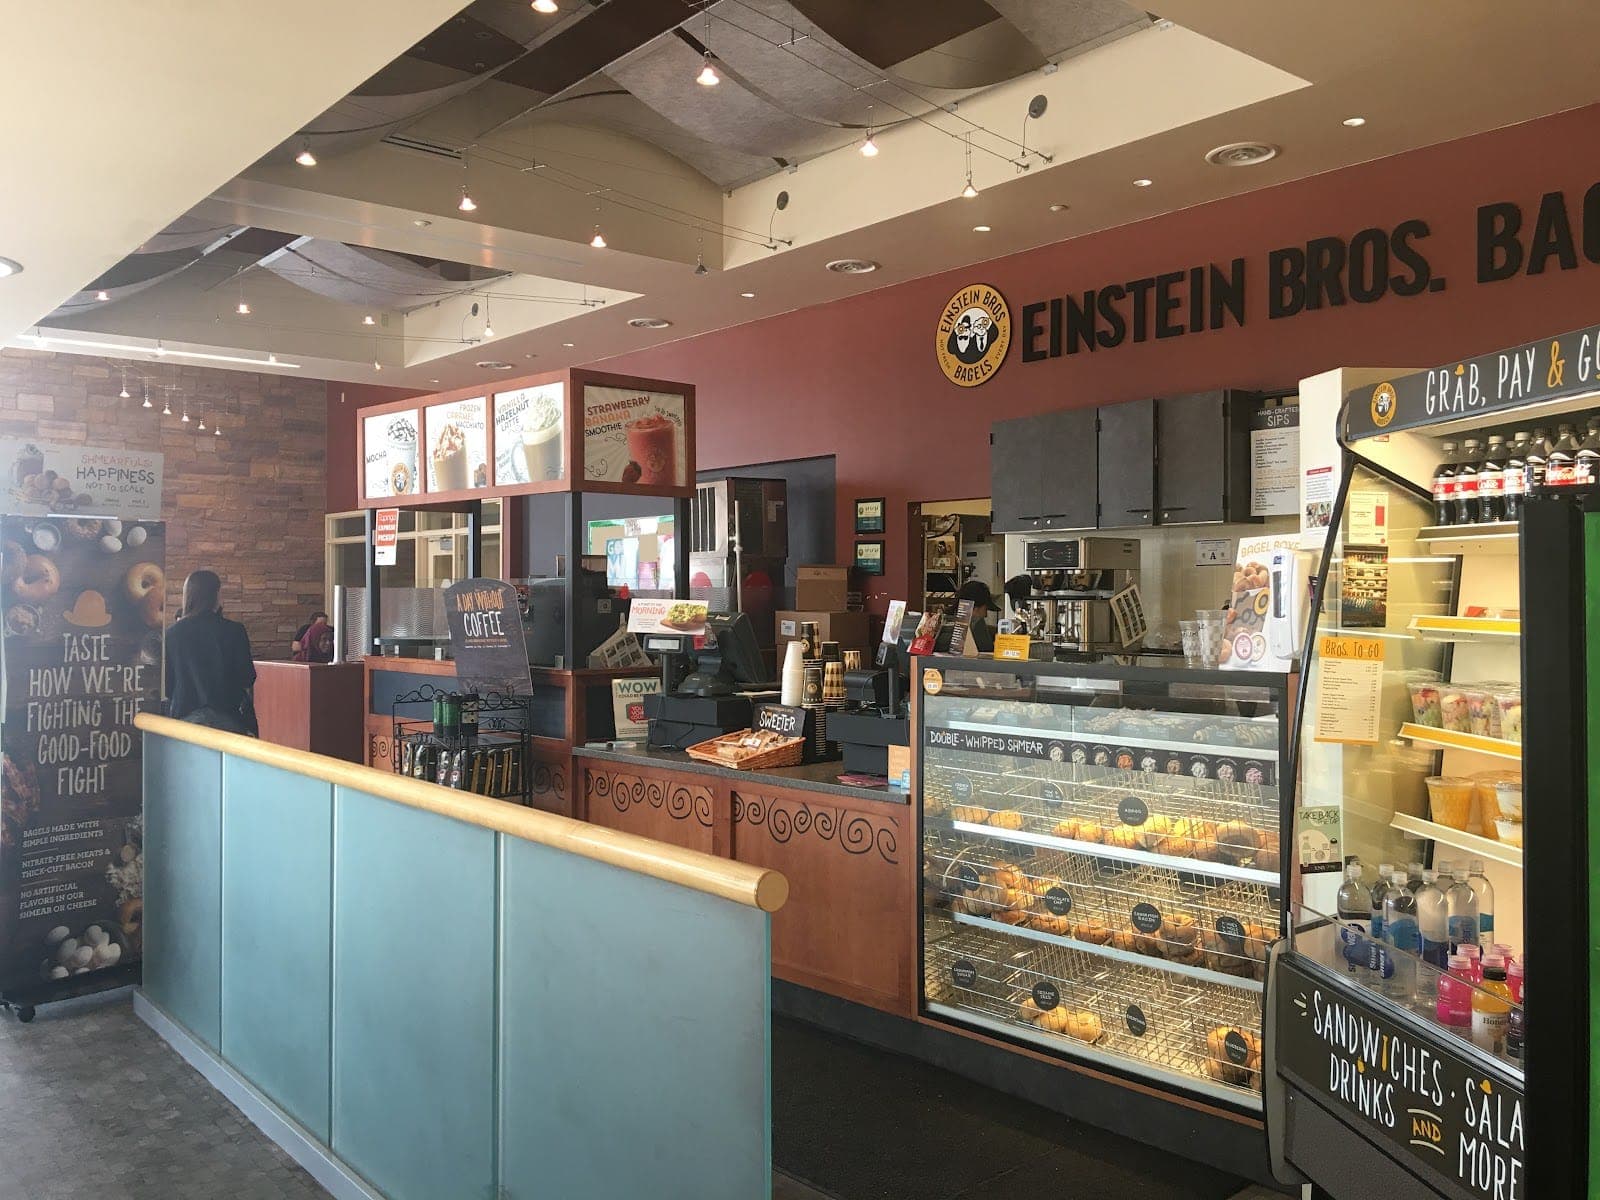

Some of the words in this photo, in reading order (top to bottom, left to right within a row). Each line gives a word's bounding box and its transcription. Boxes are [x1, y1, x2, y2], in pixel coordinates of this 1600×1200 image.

[1022, 258, 1245, 362] EINSTEIN
[1269, 219, 1445, 319] BROS.
[941, 290, 980, 333] EINSTEIN
[983, 291, 1006, 322] BROS
[954, 360, 993, 382] BAGELS
[1425, 362, 1487, 416] GRAB,
[1497, 346, 1537, 400] PAY
[1546, 340, 1567, 388] &
[1577, 331, 1600, 383] G
[495, 399, 530, 426] HAZELNUT
[587, 396, 651, 416] STRAWBERRY
[585, 410, 631, 427] BANANA
[1267, 413, 1290, 427] SIPS
[585, 422, 622, 437] SMOOTHIE
[366, 450, 387, 464] MOCHA
[76, 466, 155, 484] HAPPINESS
[106, 482, 117, 492] TO
[1241, 541, 1271, 558] BAGEL
[463, 611, 505, 637] COFFEE
[63, 633, 110, 662] TASTE
[1325, 640, 1348, 657] BROS.
[1353, 642, 1363, 658] TO
[1368, 643, 1379, 658] GO
[30, 667, 73, 698] HOW
[82, 665, 144, 694] WE'RE
[618, 681, 657, 693] WOW
[27, 699, 102, 732] FIGHTING
[759, 711, 796, 731] SWEETER
[38, 730, 131, 765] GOOD-FOOD
[1007, 738, 1044, 755] SHMEAR
[58, 764, 108, 795] FIGHT
[22, 837, 49, 849] SIMPLE
[49, 829, 104, 843] INGREDIENTS
[23, 824, 51, 838] BAGELS
[51, 822, 75, 833] MADE
[76, 820, 100, 831] WITH
[22, 852, 76, 869] NITRATE-FREE
[77, 849, 104, 860] MEATS
[22, 864, 63, 879] THICK-CUT
[65, 860, 94, 871] BACON
[20, 889, 32, 899] NO
[33, 882, 78, 896] ARTIFICIAL
[20, 896, 55, 910] FLAVORS
[55, 894, 65, 903] IN
[66, 891, 84, 900] OUR
[20, 906, 52, 920] SHMEAR
[53, 904, 65, 913] OR
[66, 898, 97, 911] CHEESE
[1313, 990, 1443, 1107] SANDWICHES
[1329, 1052, 1395, 1128] DRINKS
[1412, 1117, 1442, 1142] AND
[1459, 1131, 1522, 1200] MORE
